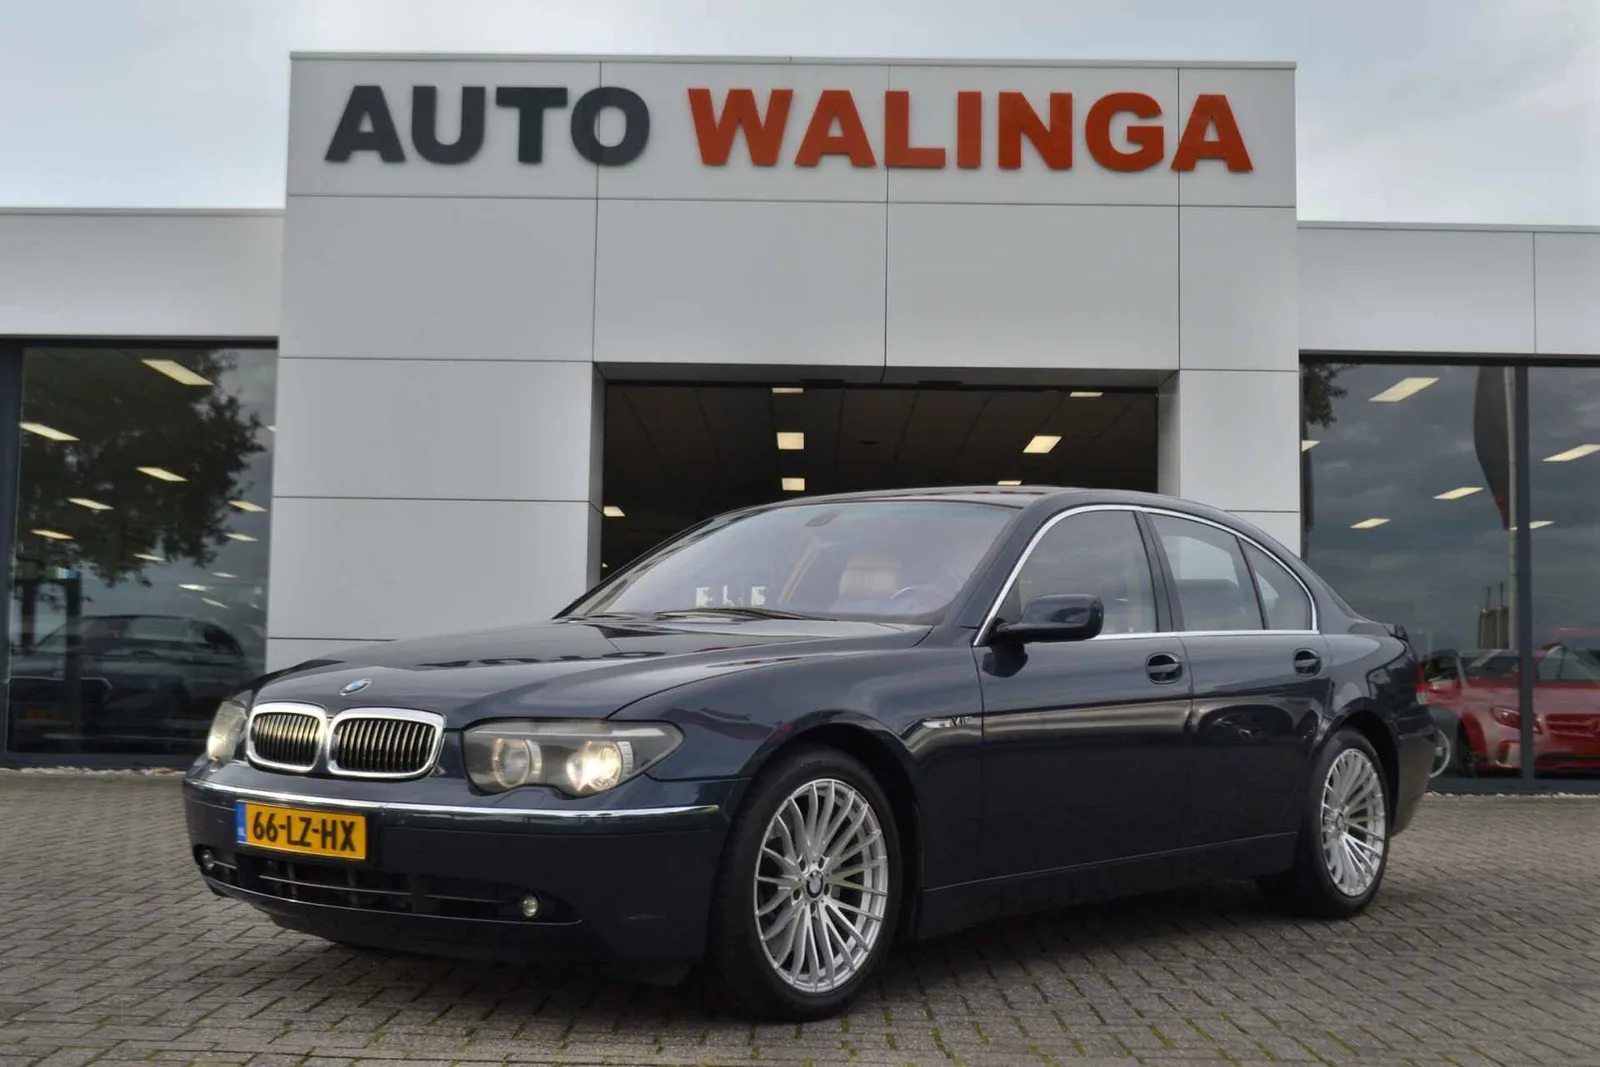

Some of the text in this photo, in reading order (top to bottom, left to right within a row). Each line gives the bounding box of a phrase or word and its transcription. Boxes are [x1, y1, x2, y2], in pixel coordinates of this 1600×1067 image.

[324, 85, 1254, 173] AUTO WALINGA
[252, 811, 356, 852] 66-LZ-HX
